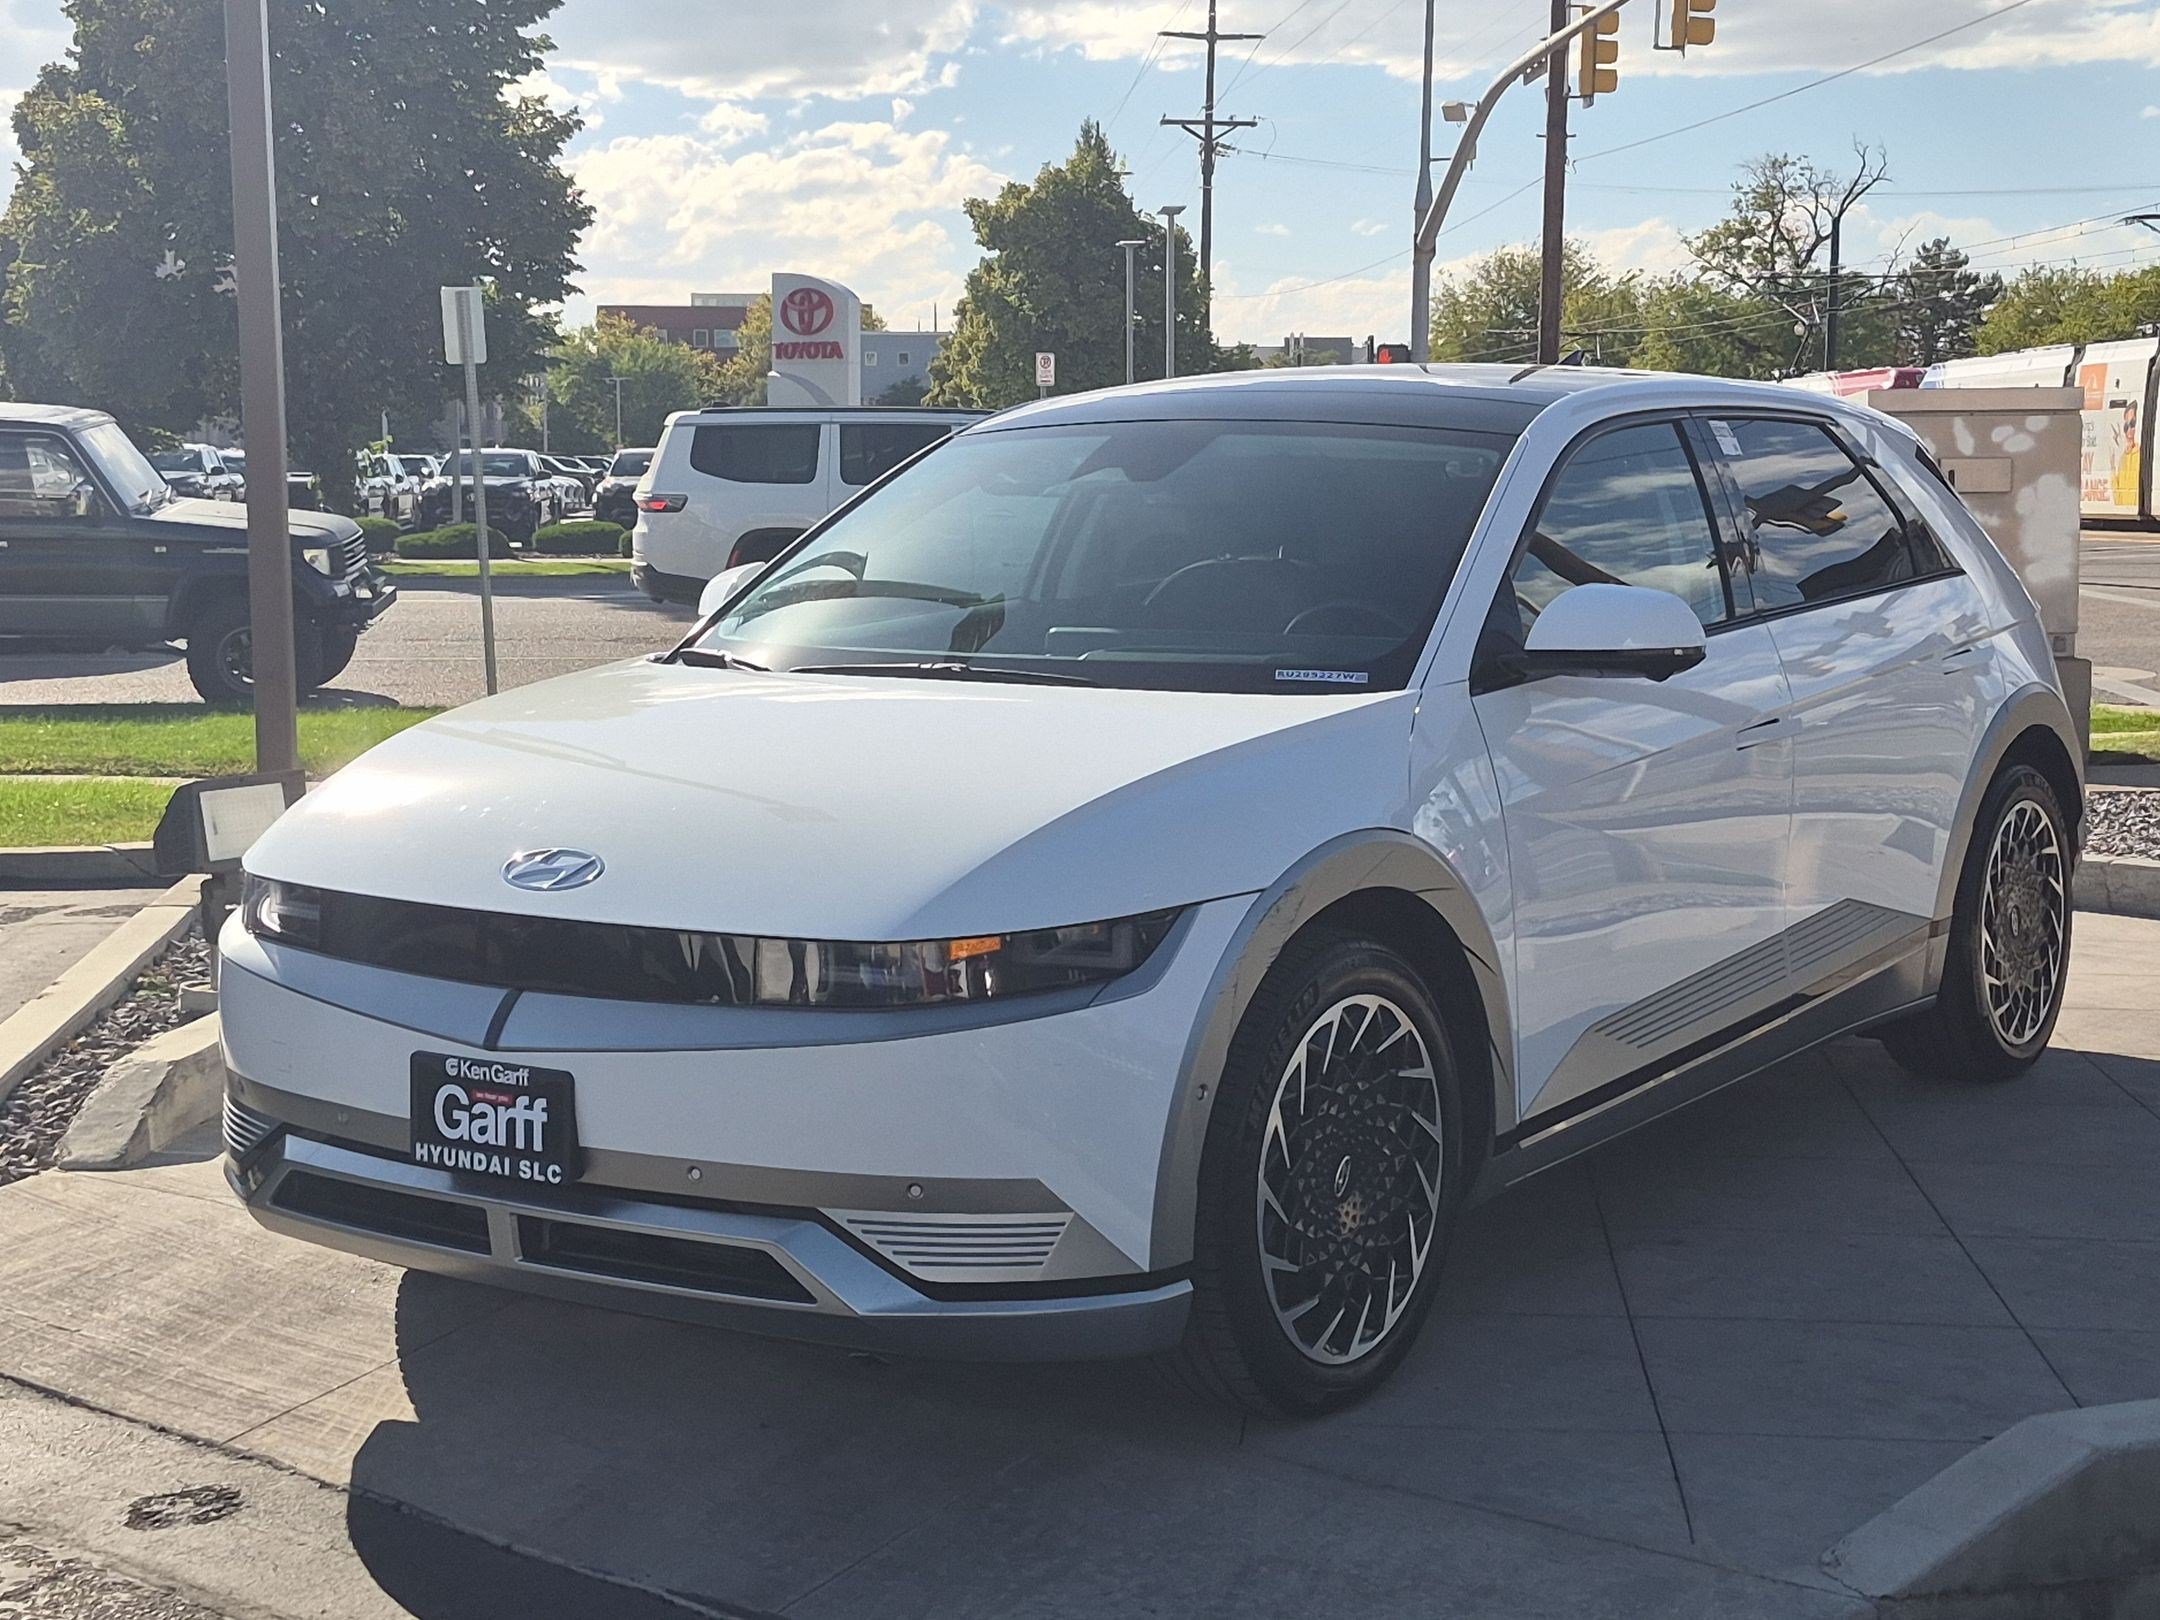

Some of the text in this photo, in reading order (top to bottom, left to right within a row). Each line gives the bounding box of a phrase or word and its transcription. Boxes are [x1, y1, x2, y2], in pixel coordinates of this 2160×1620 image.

[772, 341, 843, 359] TOYOTA
[433, 1083, 549, 1152] Garff
[415, 1141, 562, 1185] HYUNDAI SLC
